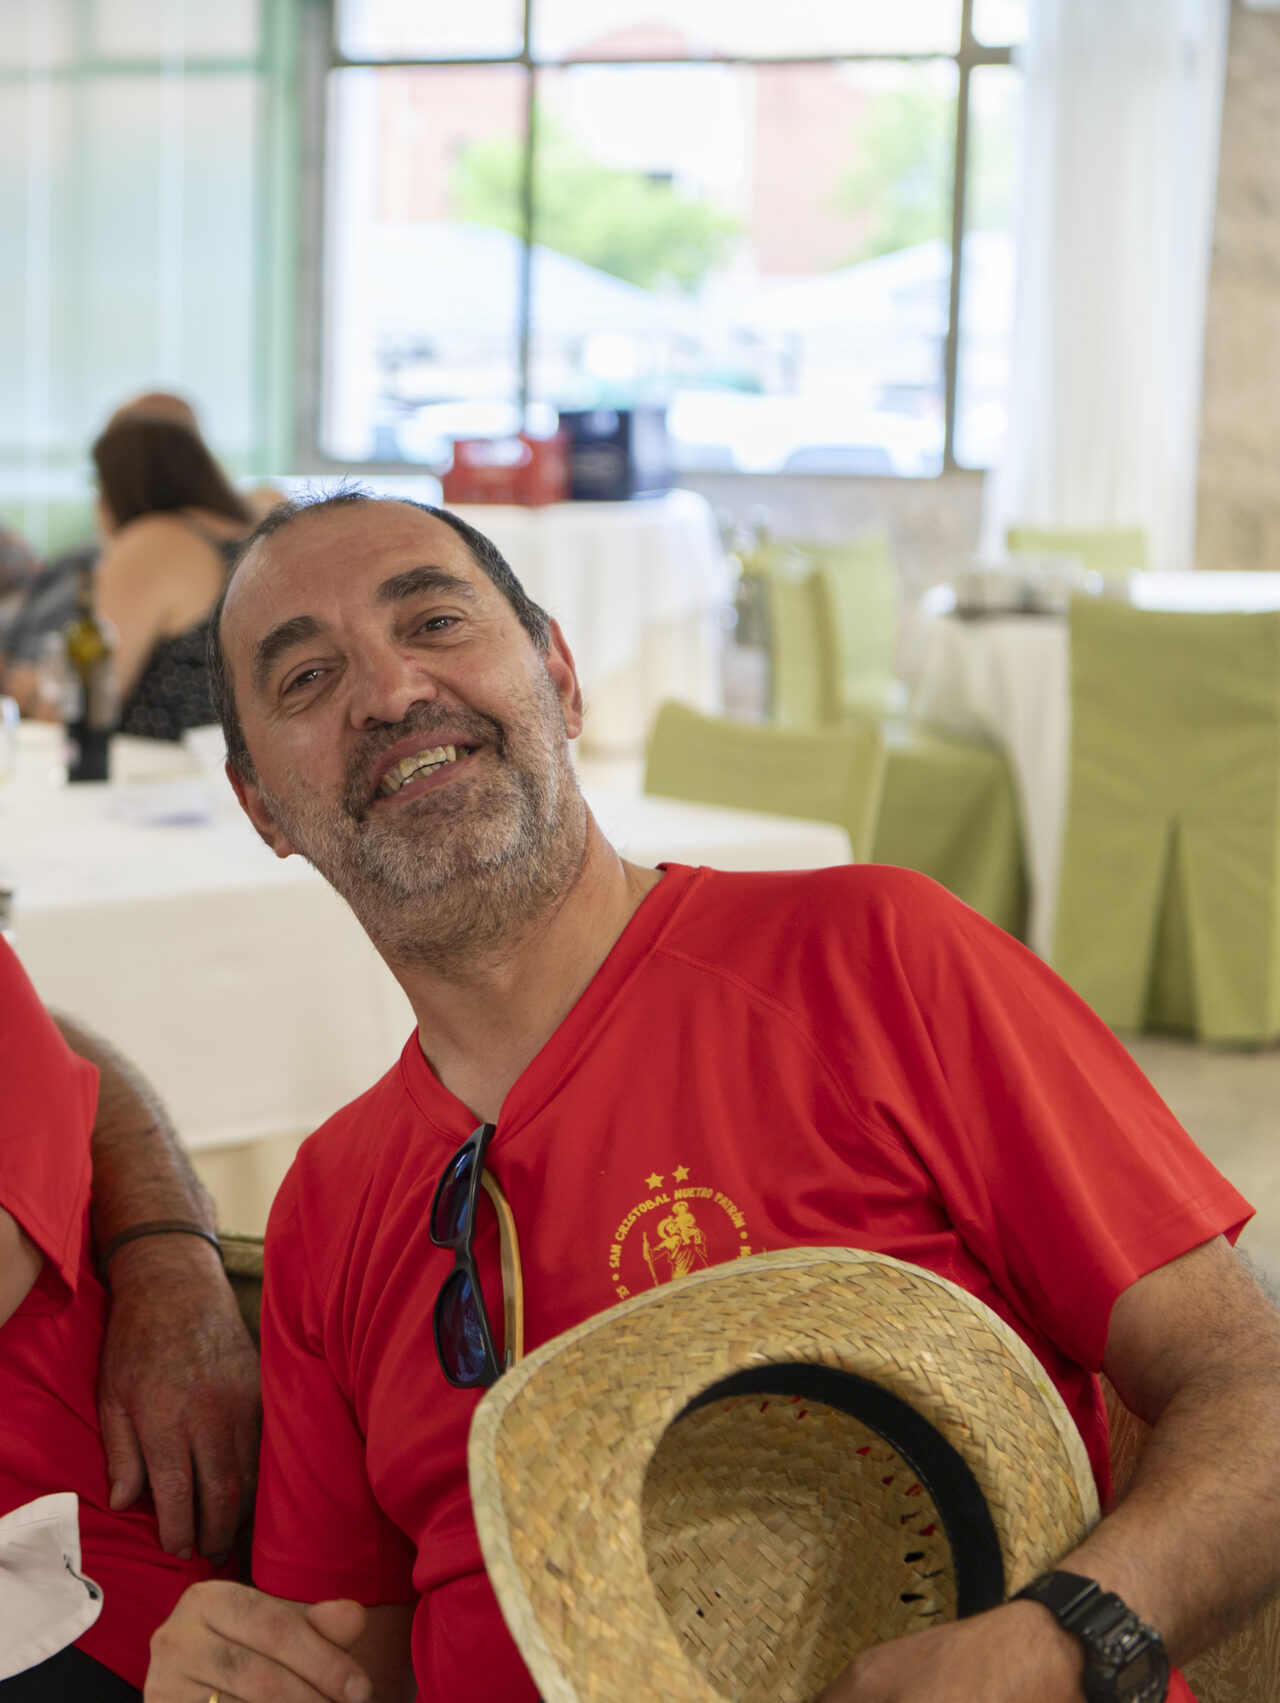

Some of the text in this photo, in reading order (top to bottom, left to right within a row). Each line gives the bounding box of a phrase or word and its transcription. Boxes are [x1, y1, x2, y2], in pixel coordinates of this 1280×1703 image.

[609, 1187, 747, 1268] SAN CRISTOBAL NUETRO PATRÓN
